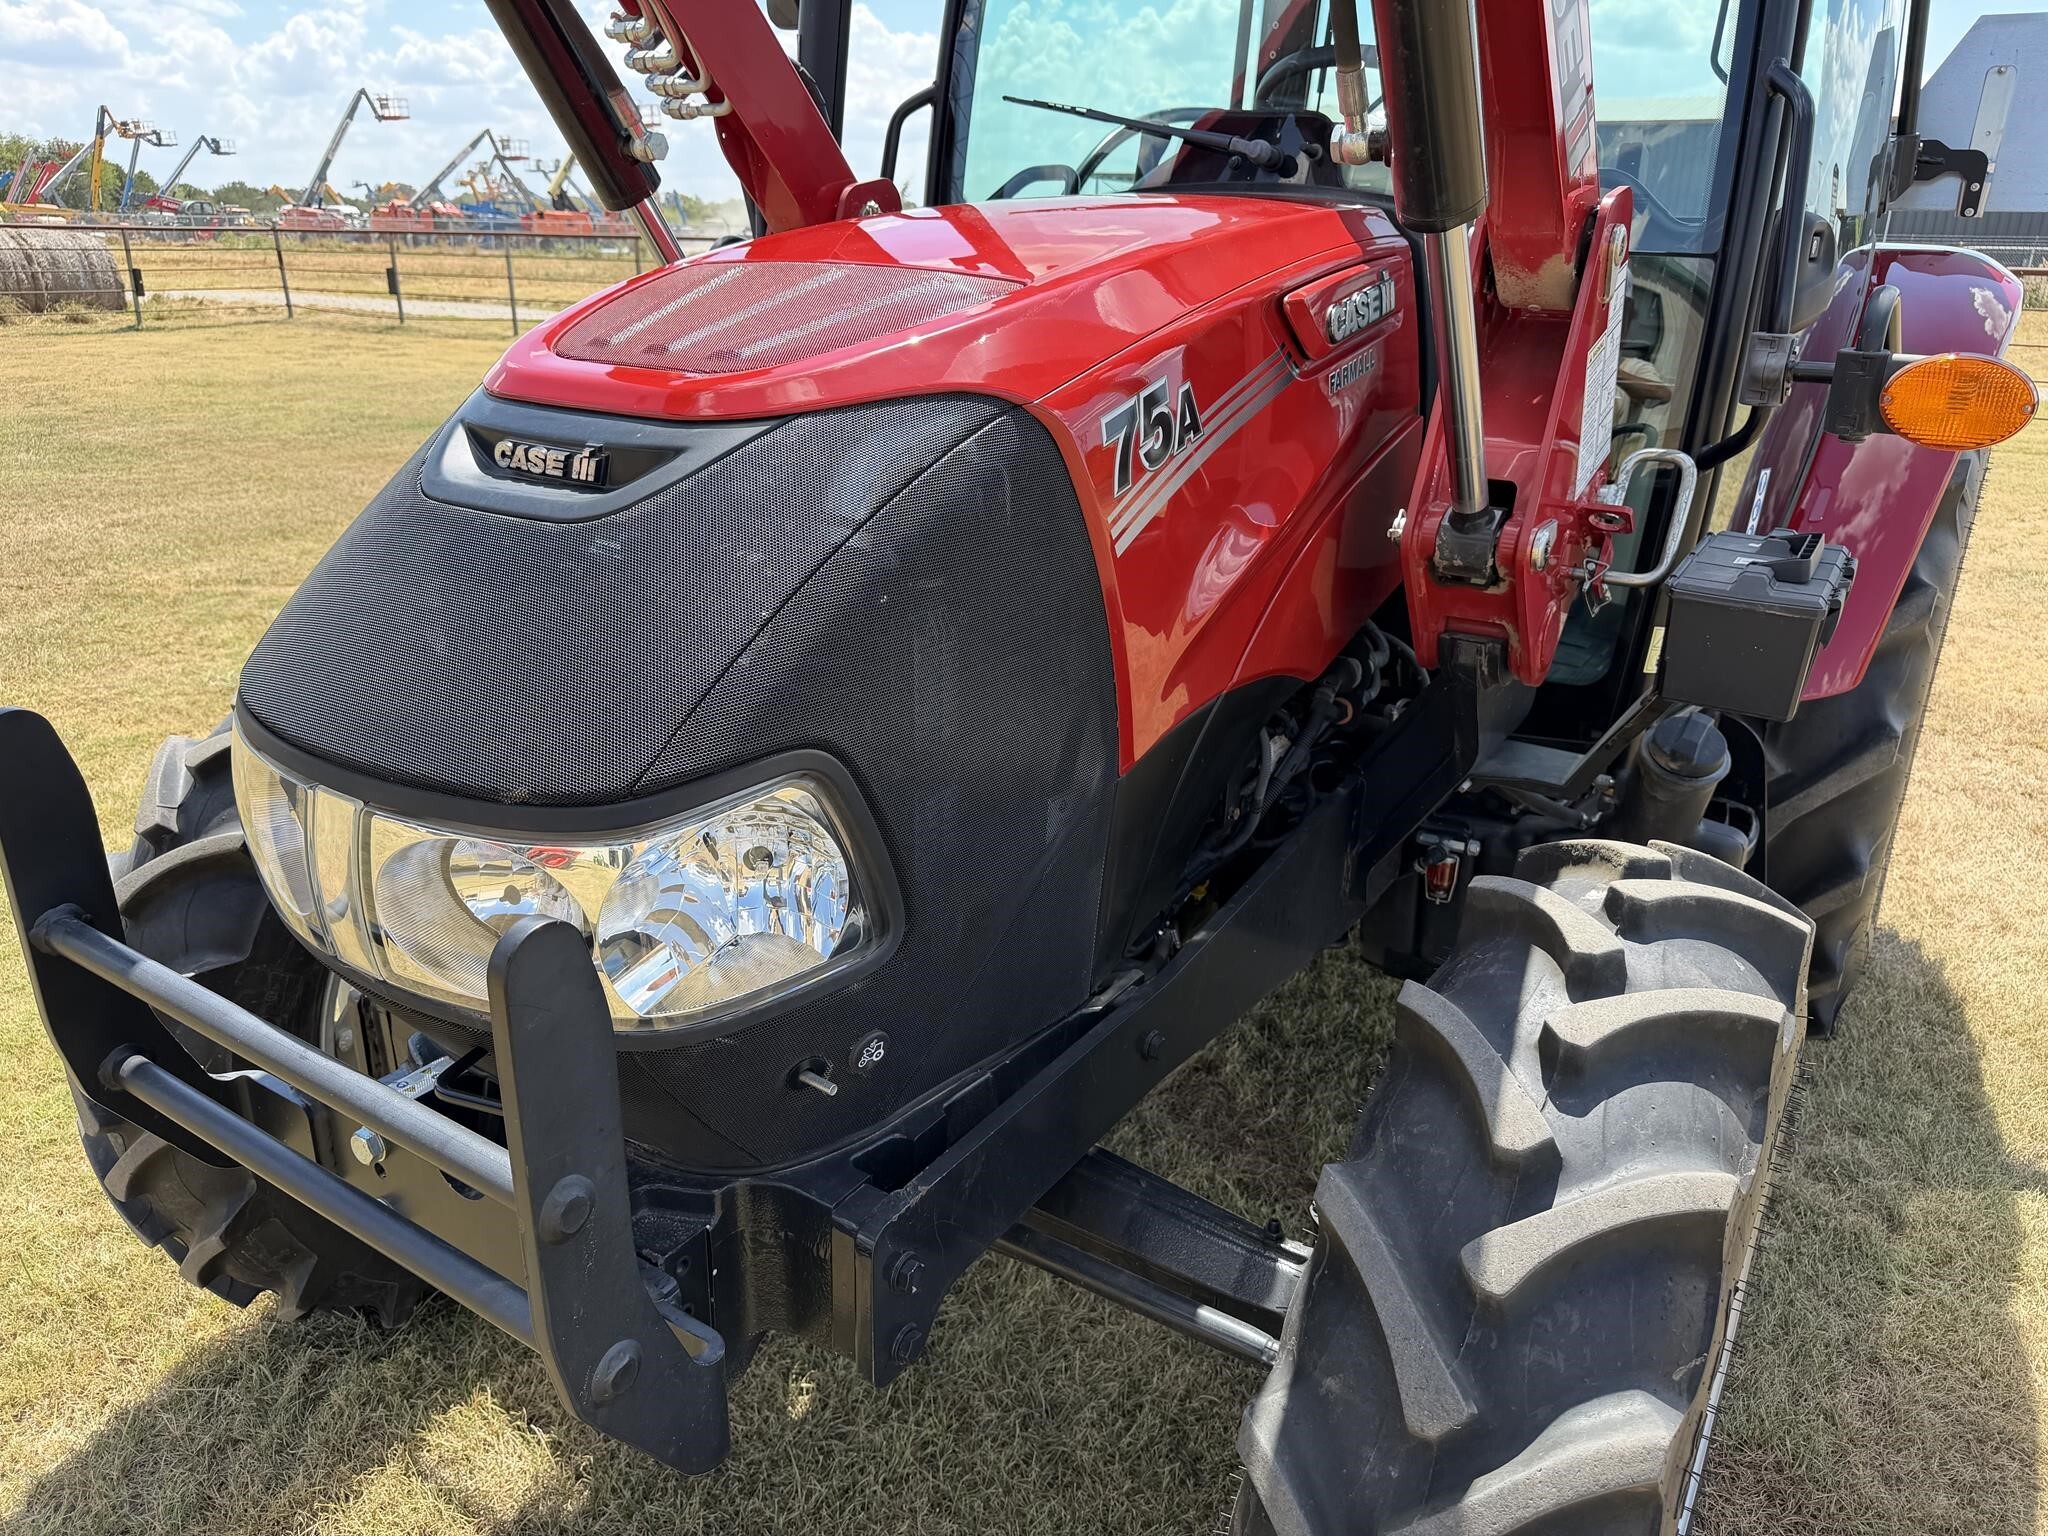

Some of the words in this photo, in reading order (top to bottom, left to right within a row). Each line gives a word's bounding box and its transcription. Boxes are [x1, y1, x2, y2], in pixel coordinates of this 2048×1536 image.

[1330, 286, 1382, 342] CASE
[1328, 349, 1377, 396] FARMALL
[494, 440, 568, 477] CASE
[1100, 375, 1204, 499] 75A
